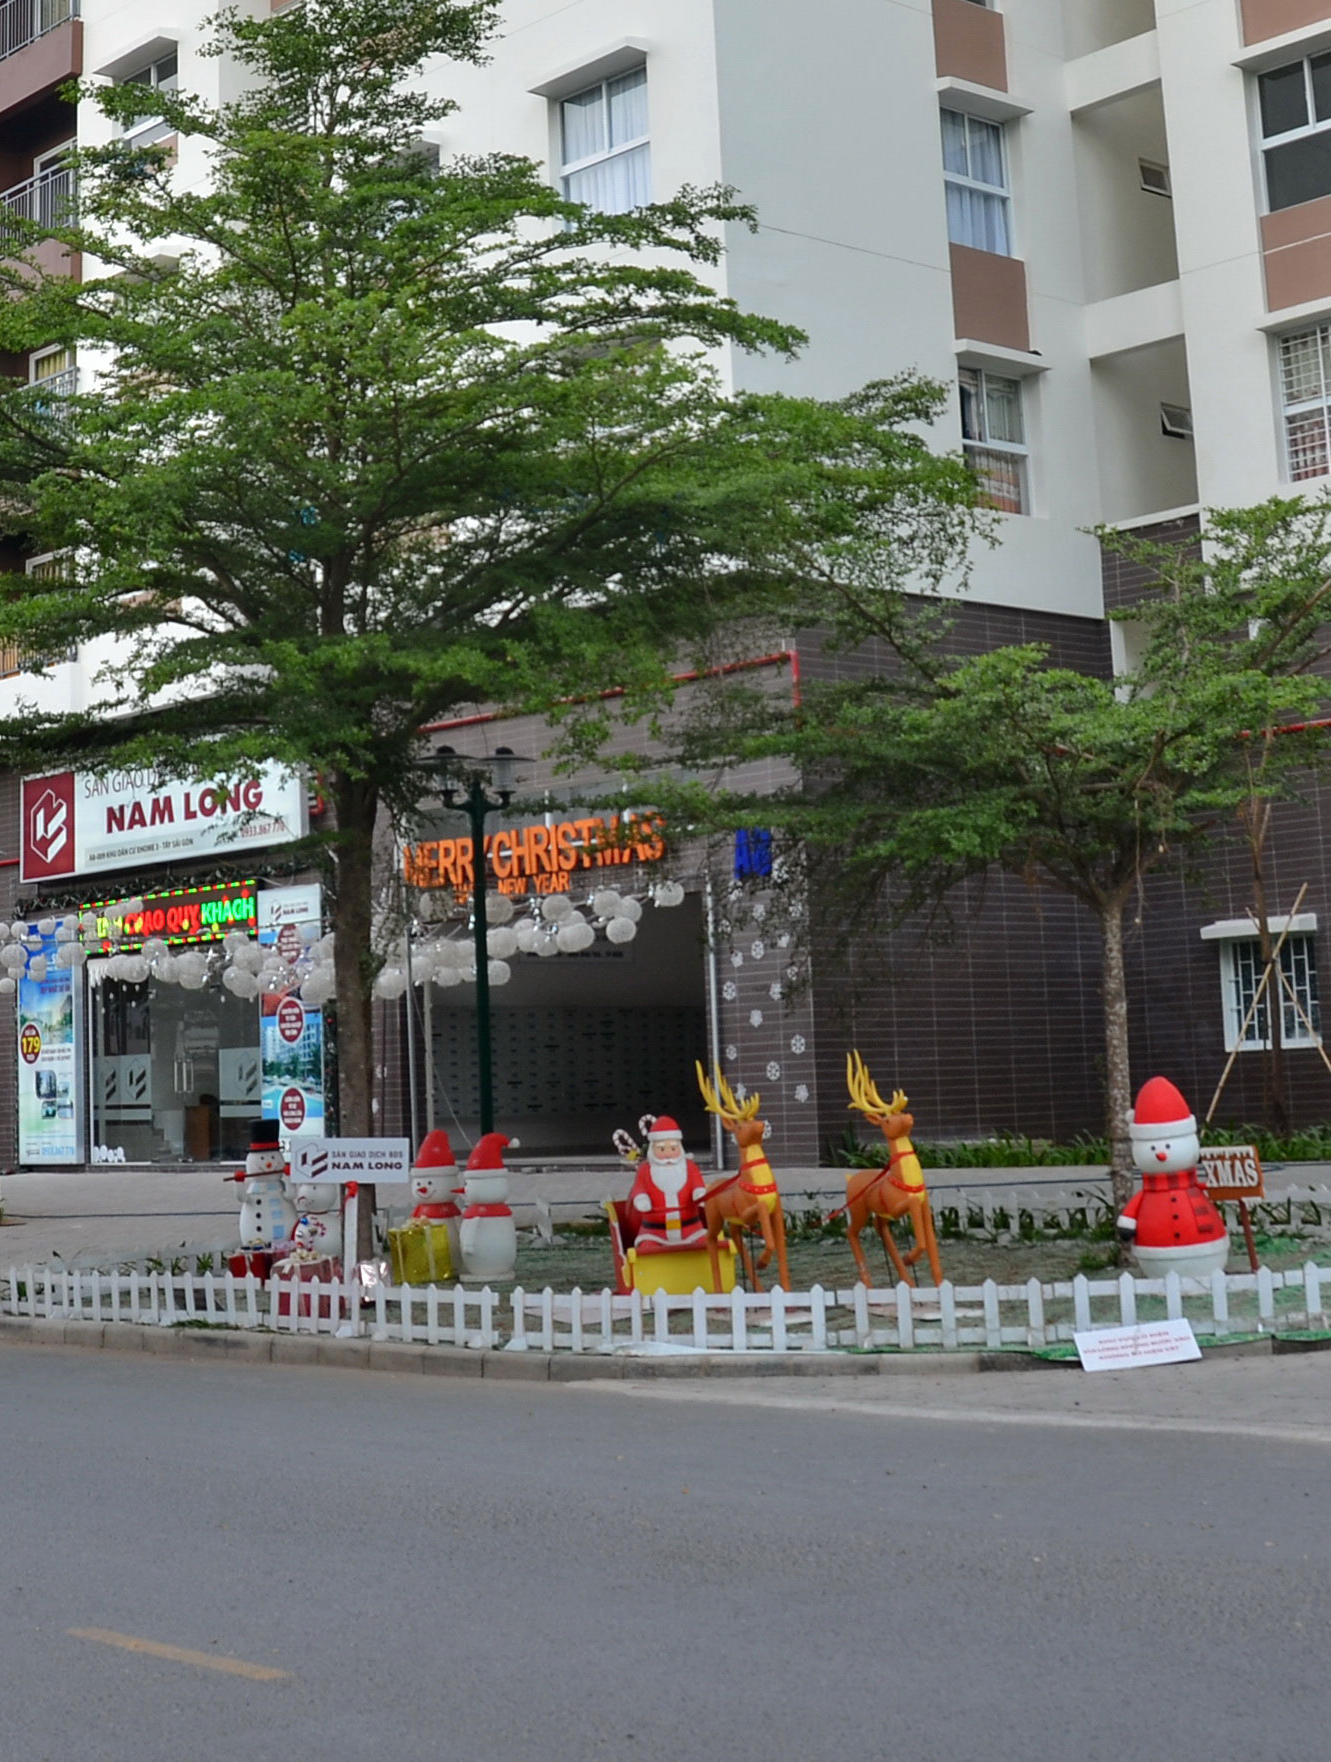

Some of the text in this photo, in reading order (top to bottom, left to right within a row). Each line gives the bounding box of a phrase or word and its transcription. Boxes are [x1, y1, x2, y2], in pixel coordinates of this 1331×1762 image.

[106, 779, 263, 834] NAM LONG
[497, 877, 528, 895] NEW
[533, 871, 571, 894] YEAR
[22, 1036, 41, 1054] 179
[331, 1161, 403, 1170] NAM LONG
[1201, 1158, 1259, 1187] XMAS
